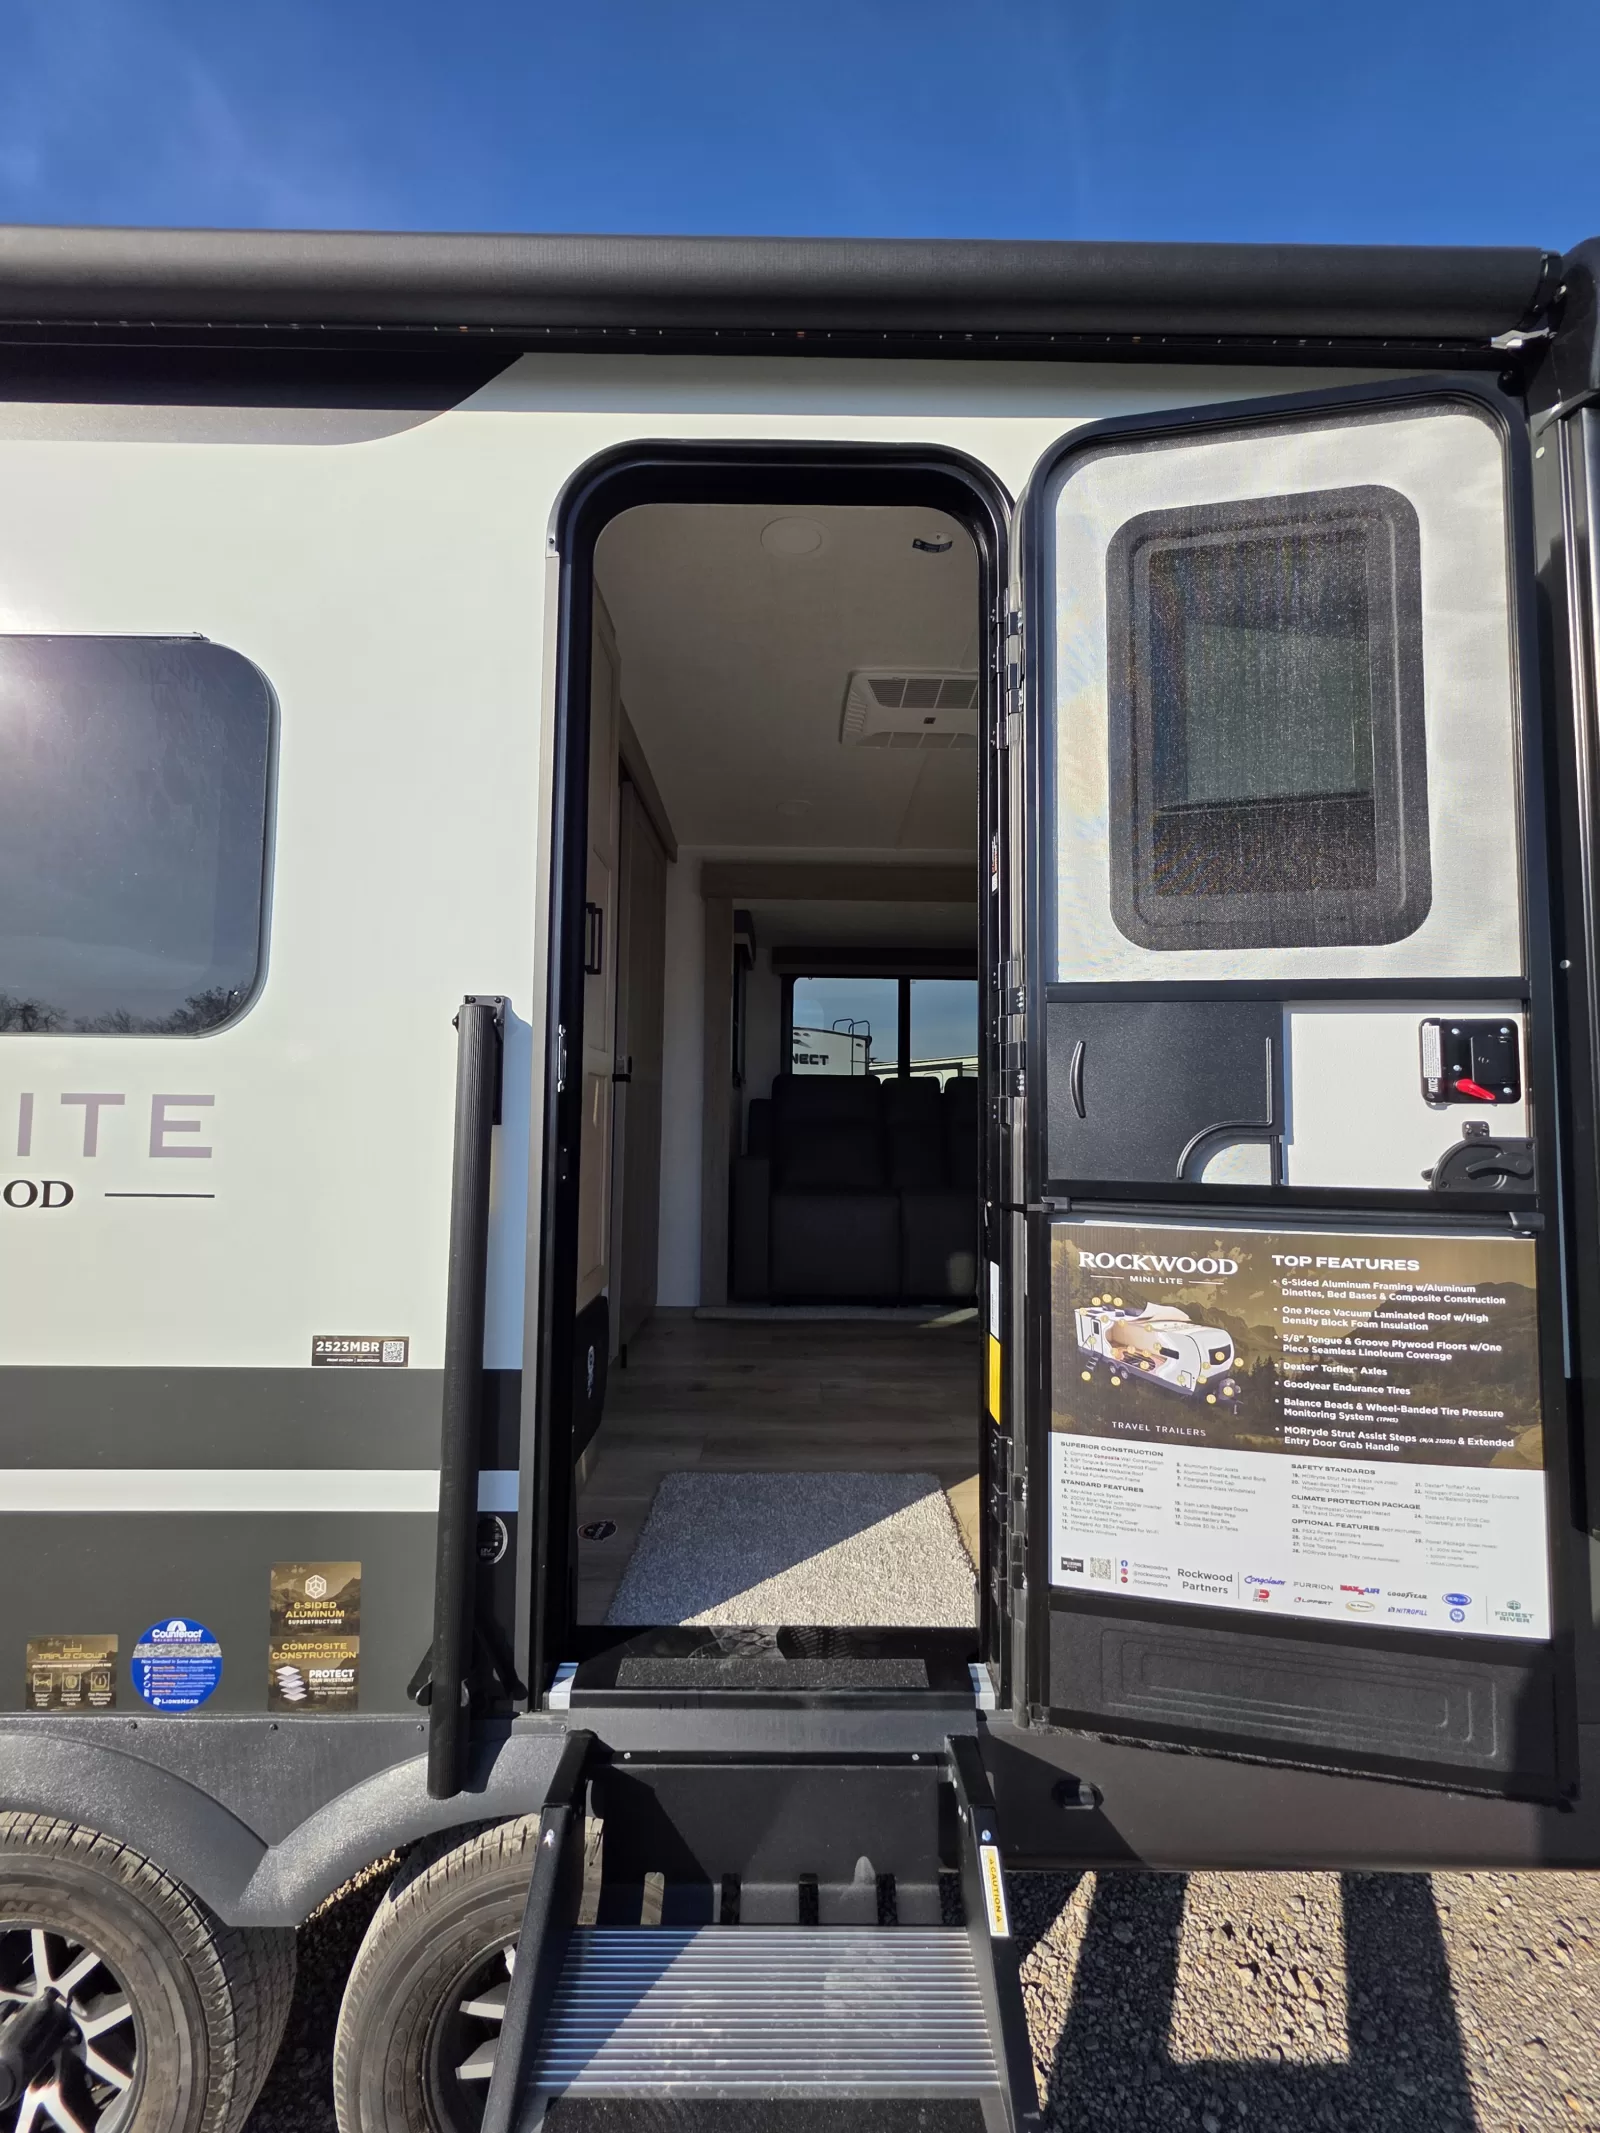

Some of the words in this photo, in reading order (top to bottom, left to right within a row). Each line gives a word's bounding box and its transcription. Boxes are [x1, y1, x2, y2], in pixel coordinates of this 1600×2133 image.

[17, 1093, 215, 1158] ITE
[1078, 1252, 1240, 1274] ROCKWOOD
[1271, 1254, 1312, 1268] TOP
[1316, 1256, 1419, 1271] FEATURES
[1129, 1275, 1154, 1283] MINI
[1281, 1277, 1319, 1287] 6-Sided
[1321, 1279, 1370, 1289] Aluminum
[1372, 1281, 1413, 1292] Framing
[1415, 1283, 1476, 1292] w/Aluminum
[1281, 1287, 1324, 1298] Dinettes,
[1326, 1290, 1346, 1298] Bed
[1348, 1291, 1377, 1299] Bases
[1379, 1292, 1386, 1300] &
[1388, 1292, 1441, 1302] Composite
[1443, 1294, 1506, 1304] Construction
[1282, 1305, 1302, 1314] One
[1304, 1307, 1330, 1315] Piece
[1332, 1308, 1371, 1317] Vacuum
[1374, 1310, 1425, 1320] Laminated
[1427, 1312, 1451, 1321] Roof
[1453, 1312, 1488, 1323] w/High
[1282, 1316, 1318, 1326] Density
[1321, 1318, 1348, 1327] Block
[1350, 1319, 1378, 1328] Foam
[1380, 1320, 1429, 1330] Insulation
[316, 1341, 380, 1352] 2523MBR
[1283, 1333, 1304, 1342] 5/8"
[1306, 1335, 1342, 1345] Tongue
[1344, 1337, 1351, 1345] &
[1353, 1337, 1389, 1347] Groove
[1391, 1339, 1434, 1349] Plywood
[1436, 1341, 1467, 1350] Floors
[1469, 1342, 1502, 1351] w/One
[1283, 1344, 1309, 1353] Piece
[1311, 1345, 1356, 1355] Seamless
[1358, 1348, 1404, 1358] Linoleum
[1405, 1350, 1452, 1361] Coverage
[1360, 1366, 1387, 1375] Axles
[1283, 1379, 1330, 1390] Goodyear
[1332, 1382, 1384, 1393] Endurance
[1386, 1385, 1410, 1395] Tires
[1283, 1397, 1321, 1408] Balance
[1324, 1400, 1354, 1410] Beads
[1355, 1402, 1363, 1410] &
[1365, 1403, 1438, 1414] Wheel-Banded
[1440, 1407, 1459, 1415] Tire
[1462, 1408, 1504, 1417] Pressure
[1283, 1407, 1336, 1420] Monitoring
[1338, 1411, 1374, 1421] System
[1111, 1421, 1150, 1431] TRAVEL
[1155, 1425, 1206, 1436] TRAILERS
[1284, 1425, 1328, 1436] MORryde
[1330, 1429, 1355, 1438] Strut
[1357, 1431, 1387, 1440] Assist
[1389, 1432, 1417, 1443] Steps
[1457, 1437, 1465, 1445] &
[1467, 1437, 1514, 1447] Extended
[1060, 1441, 1099, 1450] SUPERIOR
[1100, 1445, 1163, 1456] CONSTRUCTION
[1284, 1436, 1310, 1446] Entry
[1312, 1438, 1337, 1447] Door
[1338, 1440, 1363, 1449] Grab
[1365, 1441, 1399, 1451] Handle
[1324, 1466, 1375, 1475] STANDARDS
[1060, 1478, 1101, 1488] STANDARD
[1103, 1483, 1143, 1492] FEATURES
[1291, 1494, 1326, 1502] CLIMATE
[1327, 1497, 1380, 1506] PROTECTION
[1381, 1501, 1420, 1509] PACKAGE
[1291, 1518, 1334, 1527] OPTIONAL
[1335, 1522, 1379, 1531] FEATURES
[1177, 1568, 1232, 1582] Rockwood
[1182, 1580, 1228, 1594] Partners
[1293, 1581, 1333, 1591] FURRION
[1387, 1591, 1427, 1599] GOODYEAR
[285, 1610, 345, 1618] ALUMINUM
[1395, 1607, 1427, 1616] NITROFILL
[152, 1629, 203, 1638] Counteract
[309, 1669, 354, 1678] PROTECT
[991, 1866, 1001, 1912] CAUTION
